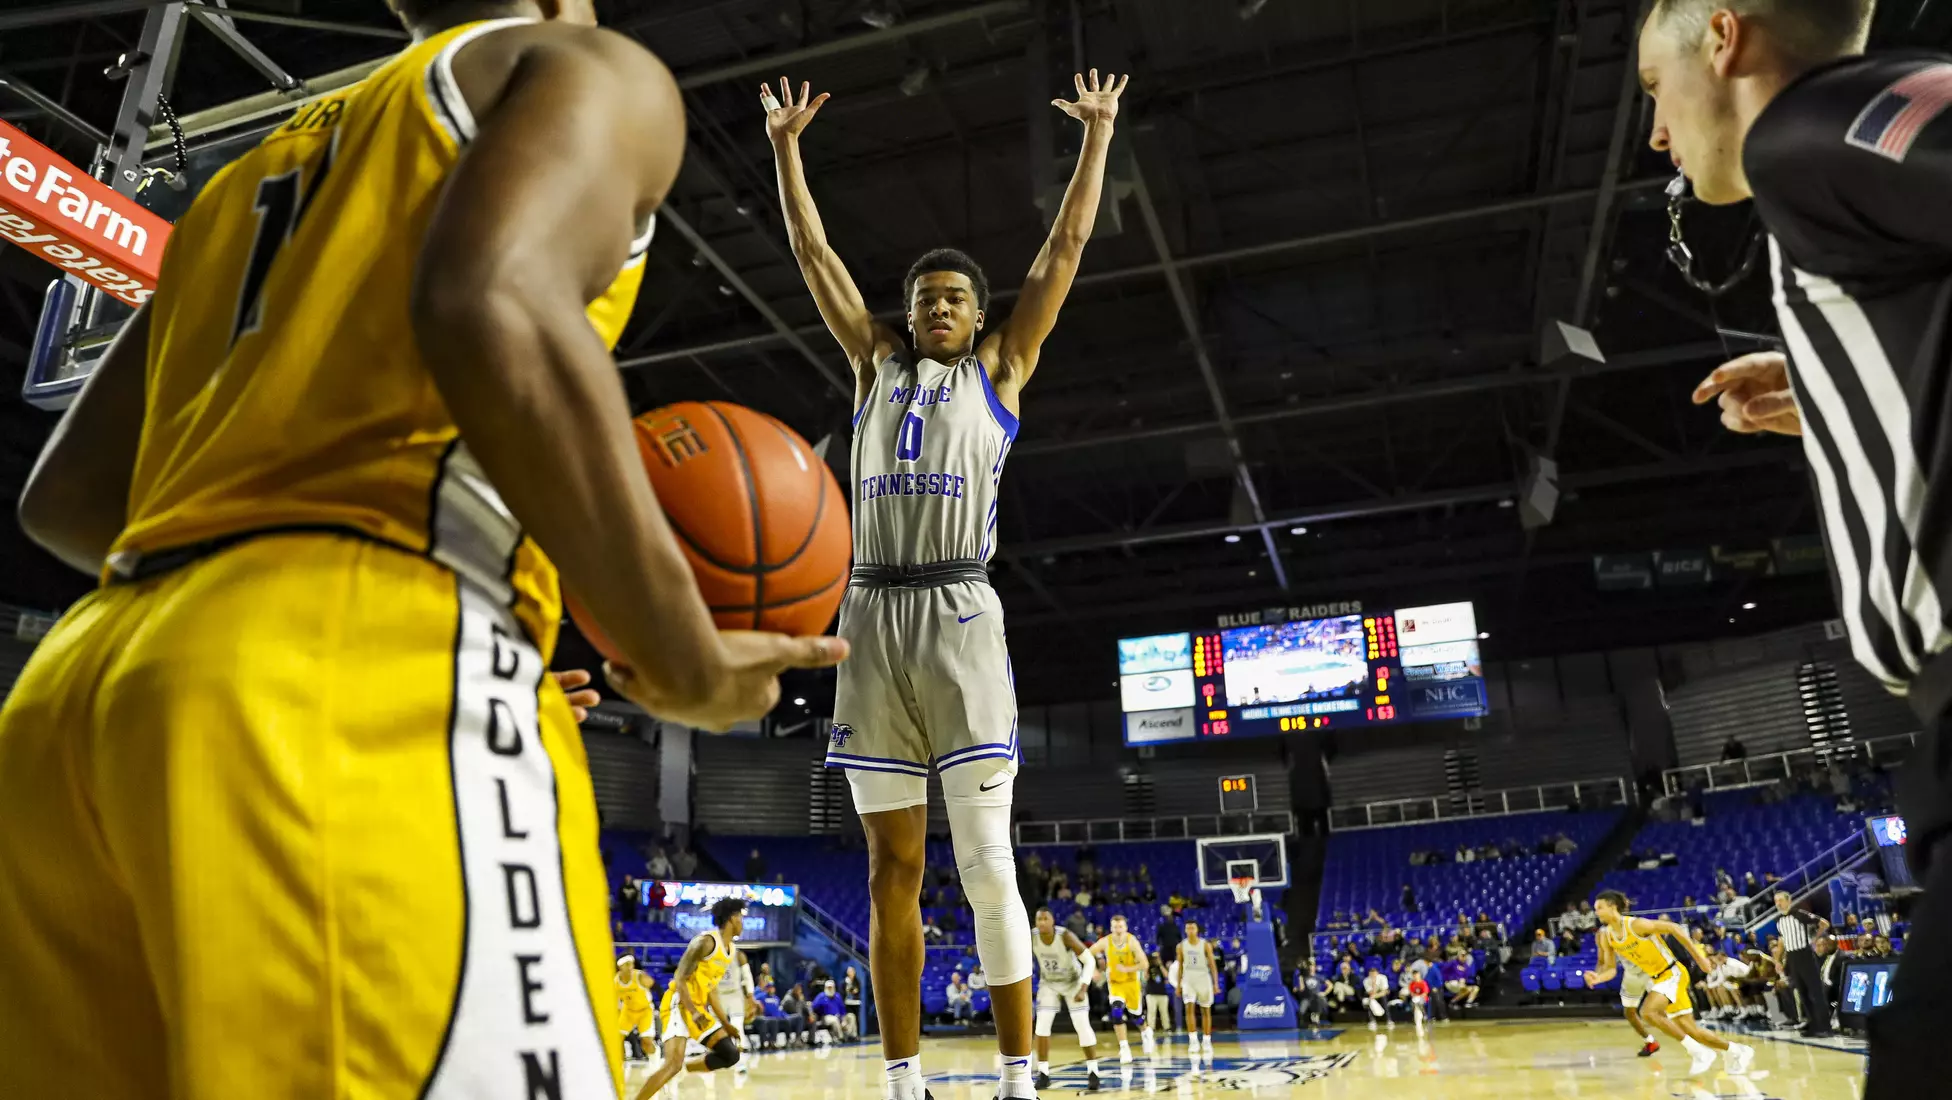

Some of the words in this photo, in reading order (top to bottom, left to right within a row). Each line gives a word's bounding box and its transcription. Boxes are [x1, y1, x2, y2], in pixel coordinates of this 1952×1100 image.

[0, 205, 156, 304] StateFa
[896, 411, 926, 463] 0
[861, 472, 965, 501] TENNESSEE
[1217, 612, 1261, 628] BLUE
[1288, 601, 1362, 620] RAIDERS
[1425, 685, 1466, 702] NHC
[1138, 717, 1183, 730] Ascend
[1377, 705, 1396, 720] 63
[1212, 720, 1230, 735] 65
[486, 622, 564, 1100] GOLDEN
[1244, 1001, 1285, 1016] Ascend
